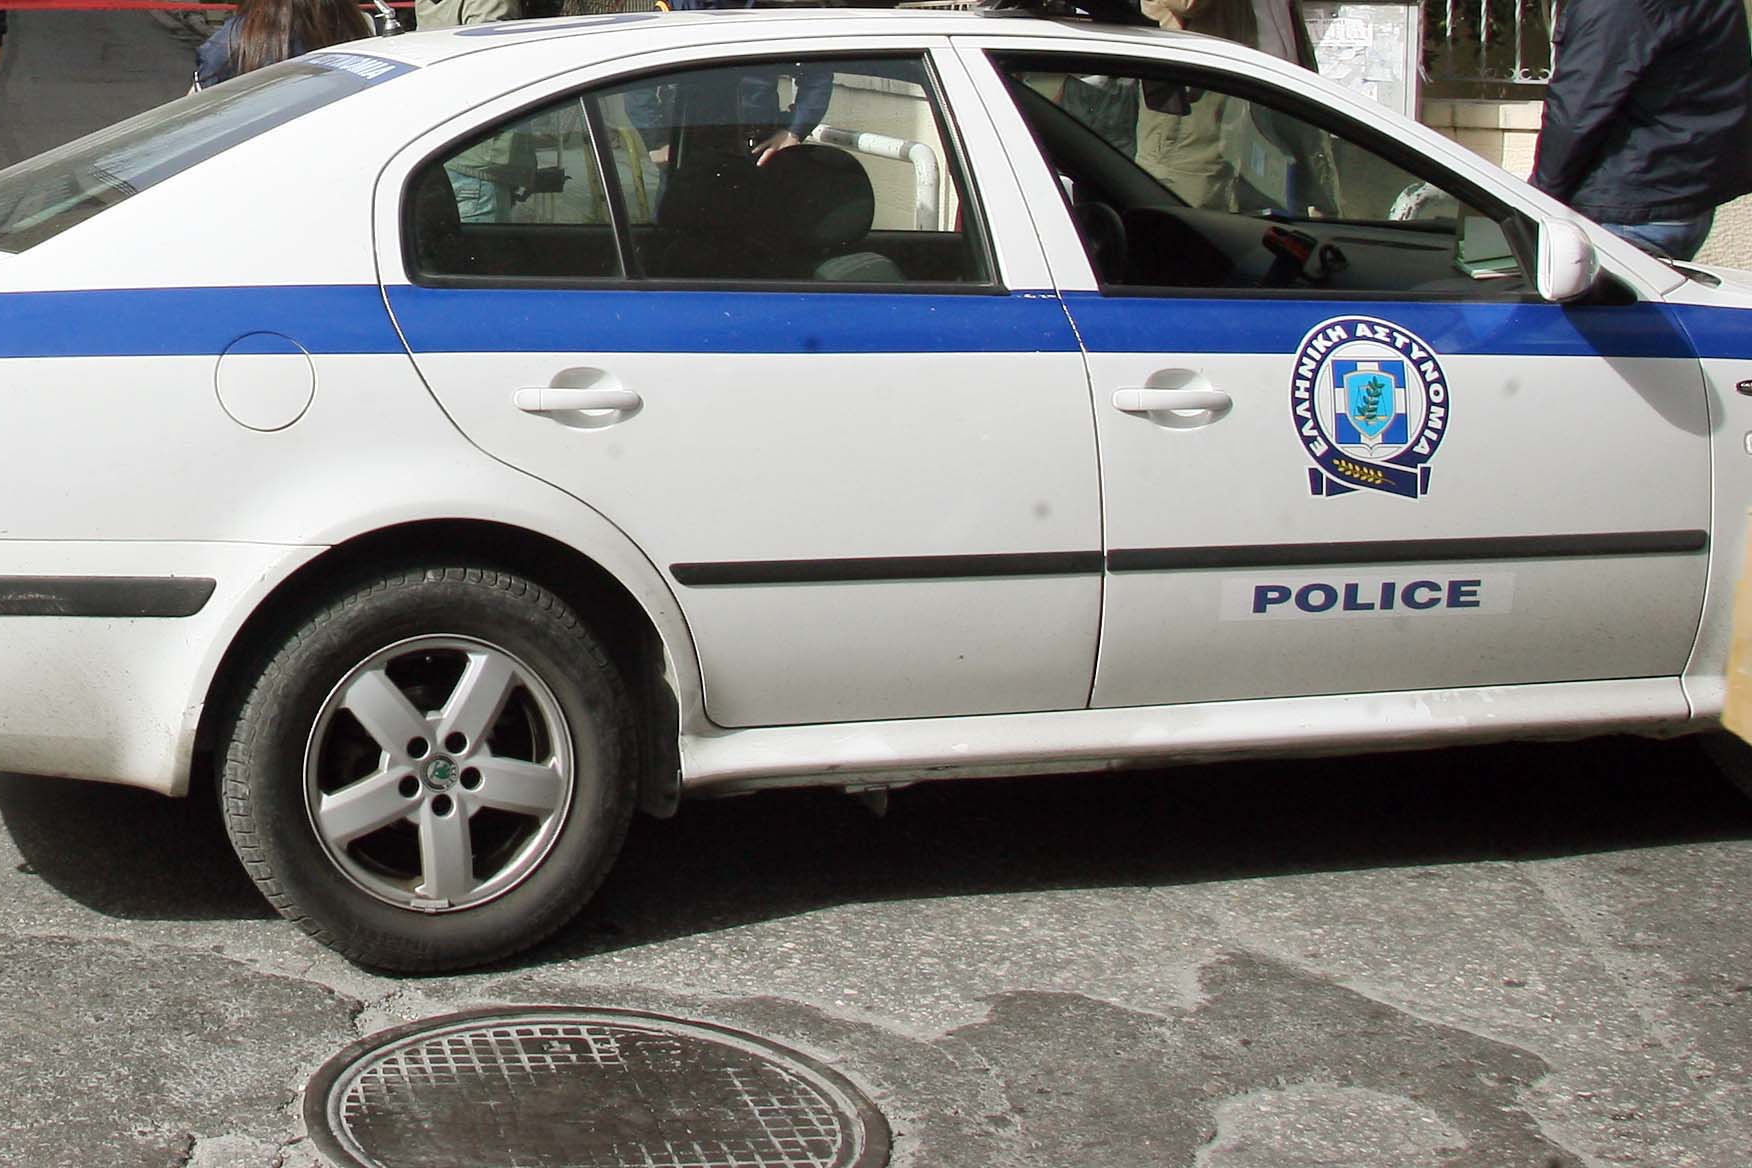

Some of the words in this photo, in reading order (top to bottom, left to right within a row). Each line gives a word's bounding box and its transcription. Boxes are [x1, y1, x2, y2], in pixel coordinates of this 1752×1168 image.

[1294, 324, 1348, 457] ΕΛΛΗΝΙΚΗ
[1354, 323, 1447, 456] ΑΣΤΥΝΟΜΙΑ
[1252, 579, 1482, 614] POLICE
